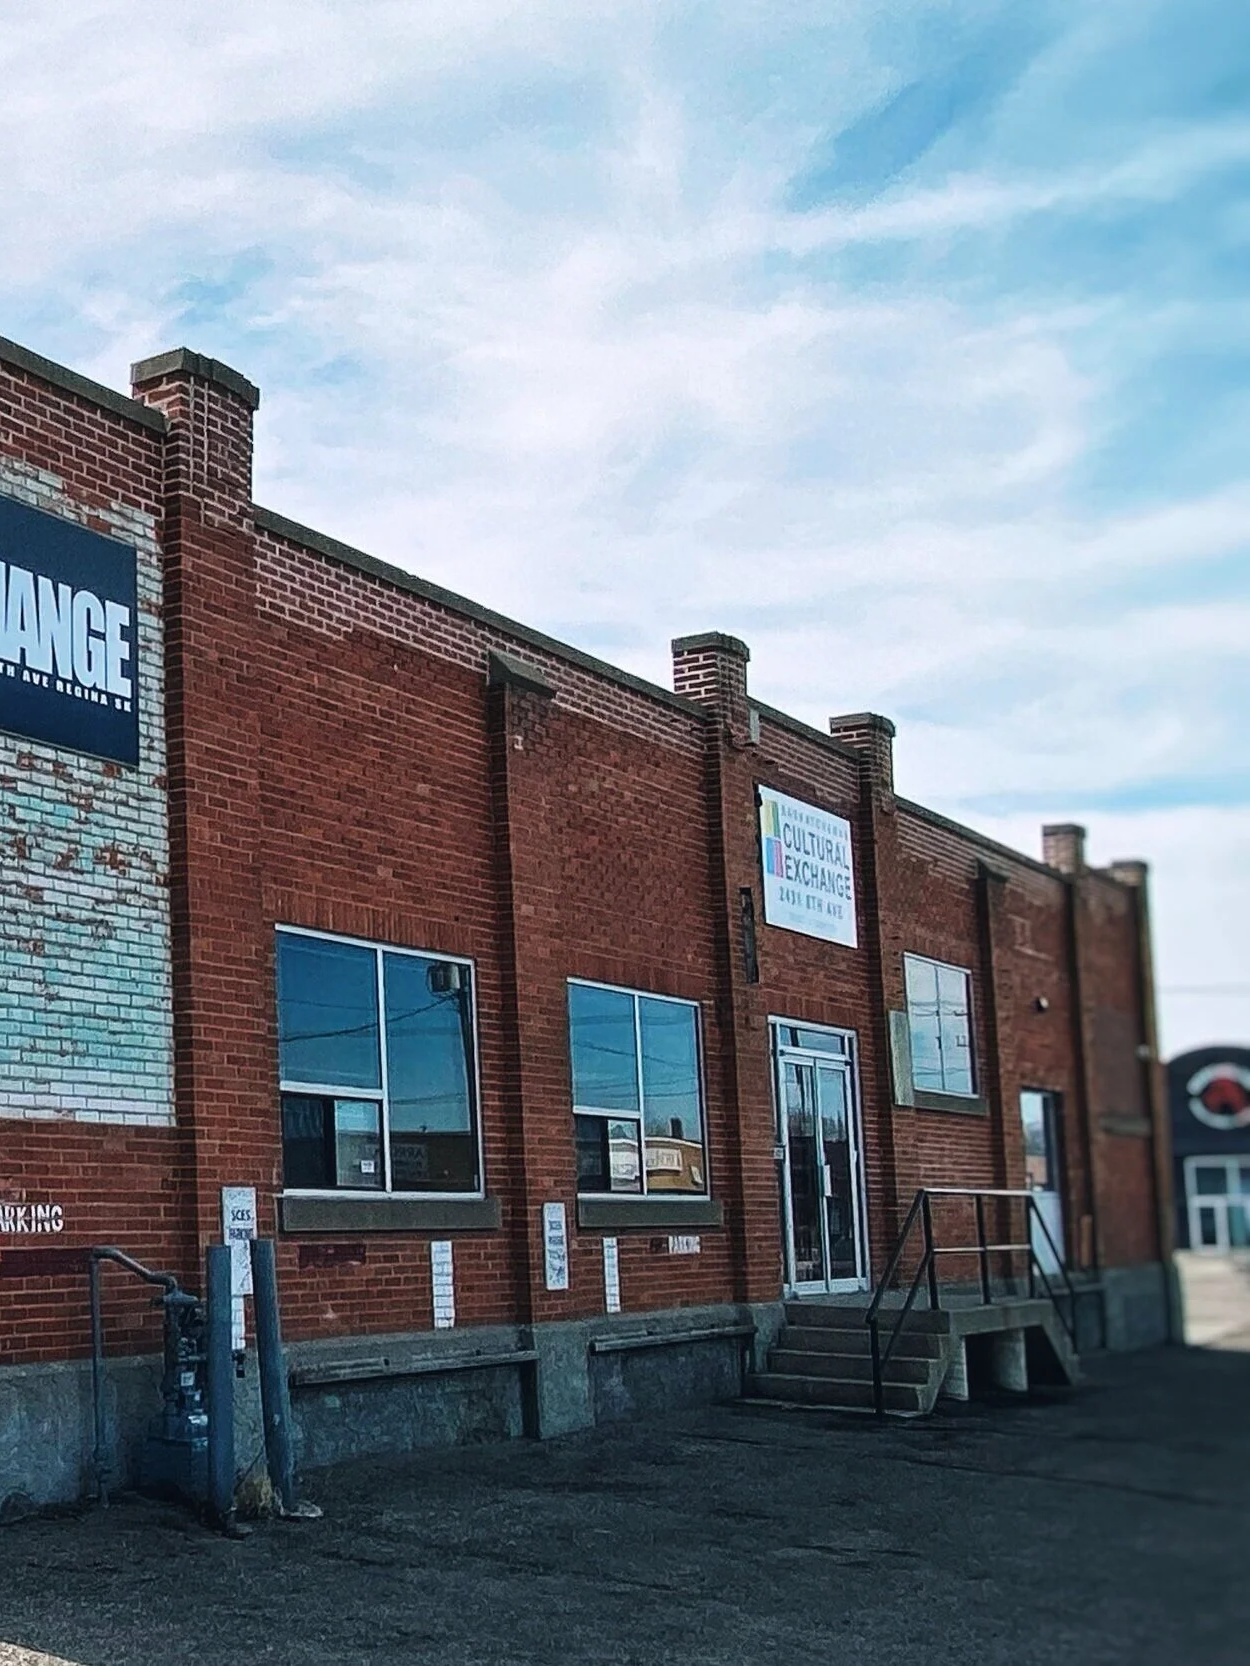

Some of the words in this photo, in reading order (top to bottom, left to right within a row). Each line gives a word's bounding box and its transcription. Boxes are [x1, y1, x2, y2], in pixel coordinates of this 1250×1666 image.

[23, 669, 49, 688] AVE
[56, 680, 108, 706] REGINA
[114, 698, 132, 712] SK
[783, 822, 850, 871] CULTURAL
[785, 854, 852, 900] EXCHANGE
[779, 885, 801, 906] 2431
[805, 893, 823, 913] 8TH
[826, 901, 844, 920] AVE
